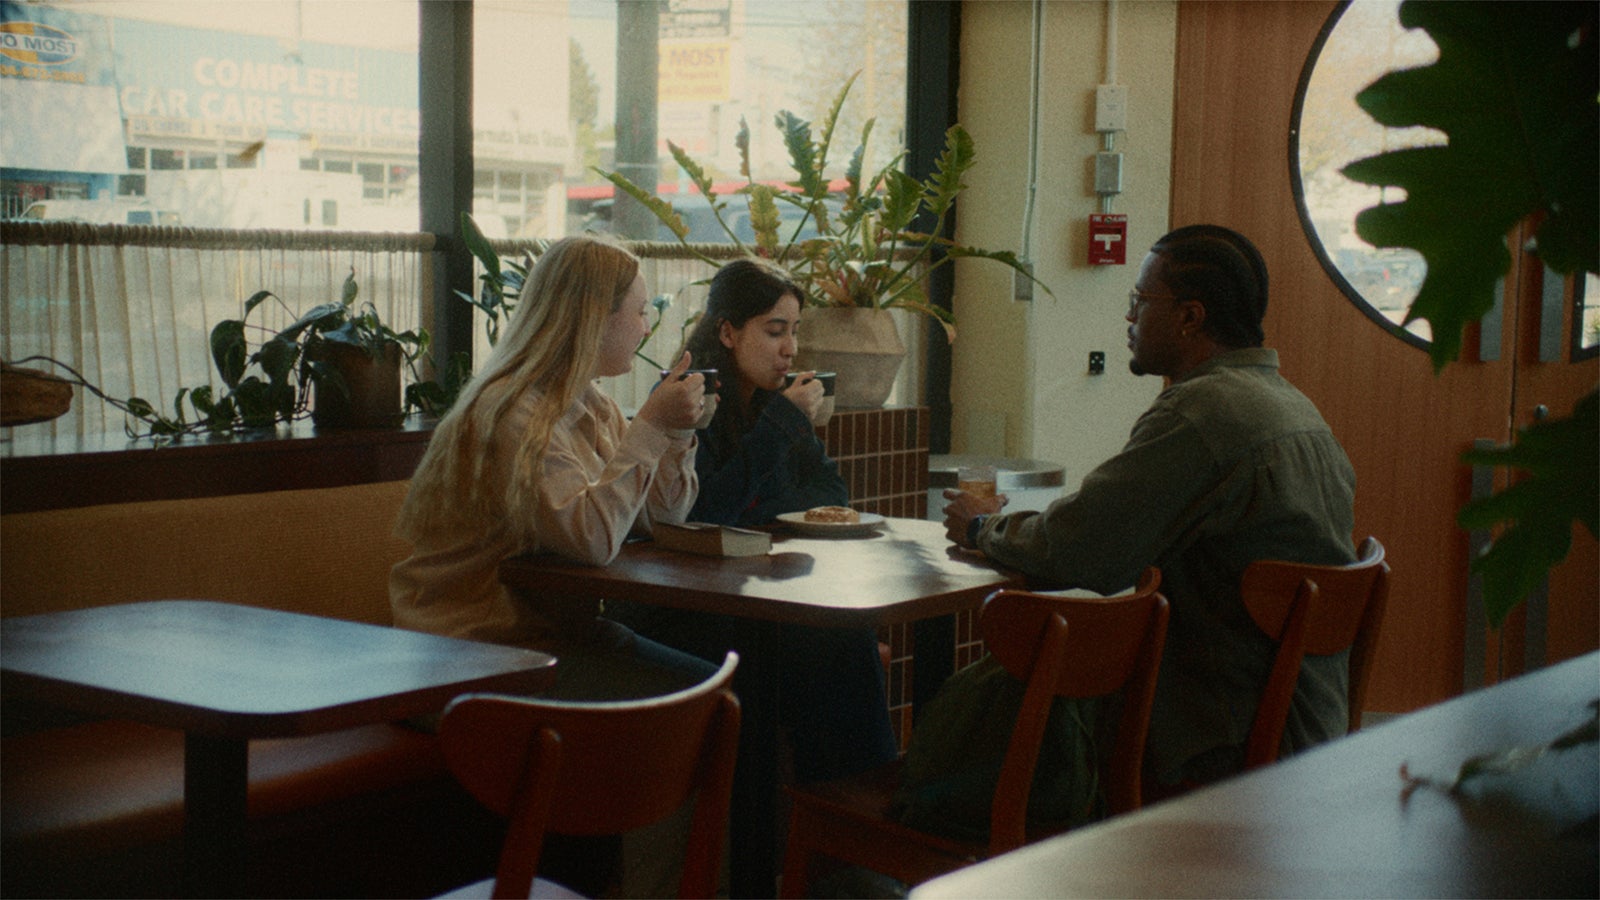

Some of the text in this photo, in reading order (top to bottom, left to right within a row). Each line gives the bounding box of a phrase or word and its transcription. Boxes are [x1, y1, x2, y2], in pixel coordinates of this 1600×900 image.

[0, 34, 76, 54] O MOST
[670, 48, 728, 66] MOST
[195, 57, 358, 99] COMPLETE
[121, 85, 190, 118] CAR
[201, 92, 284, 128] CARE
